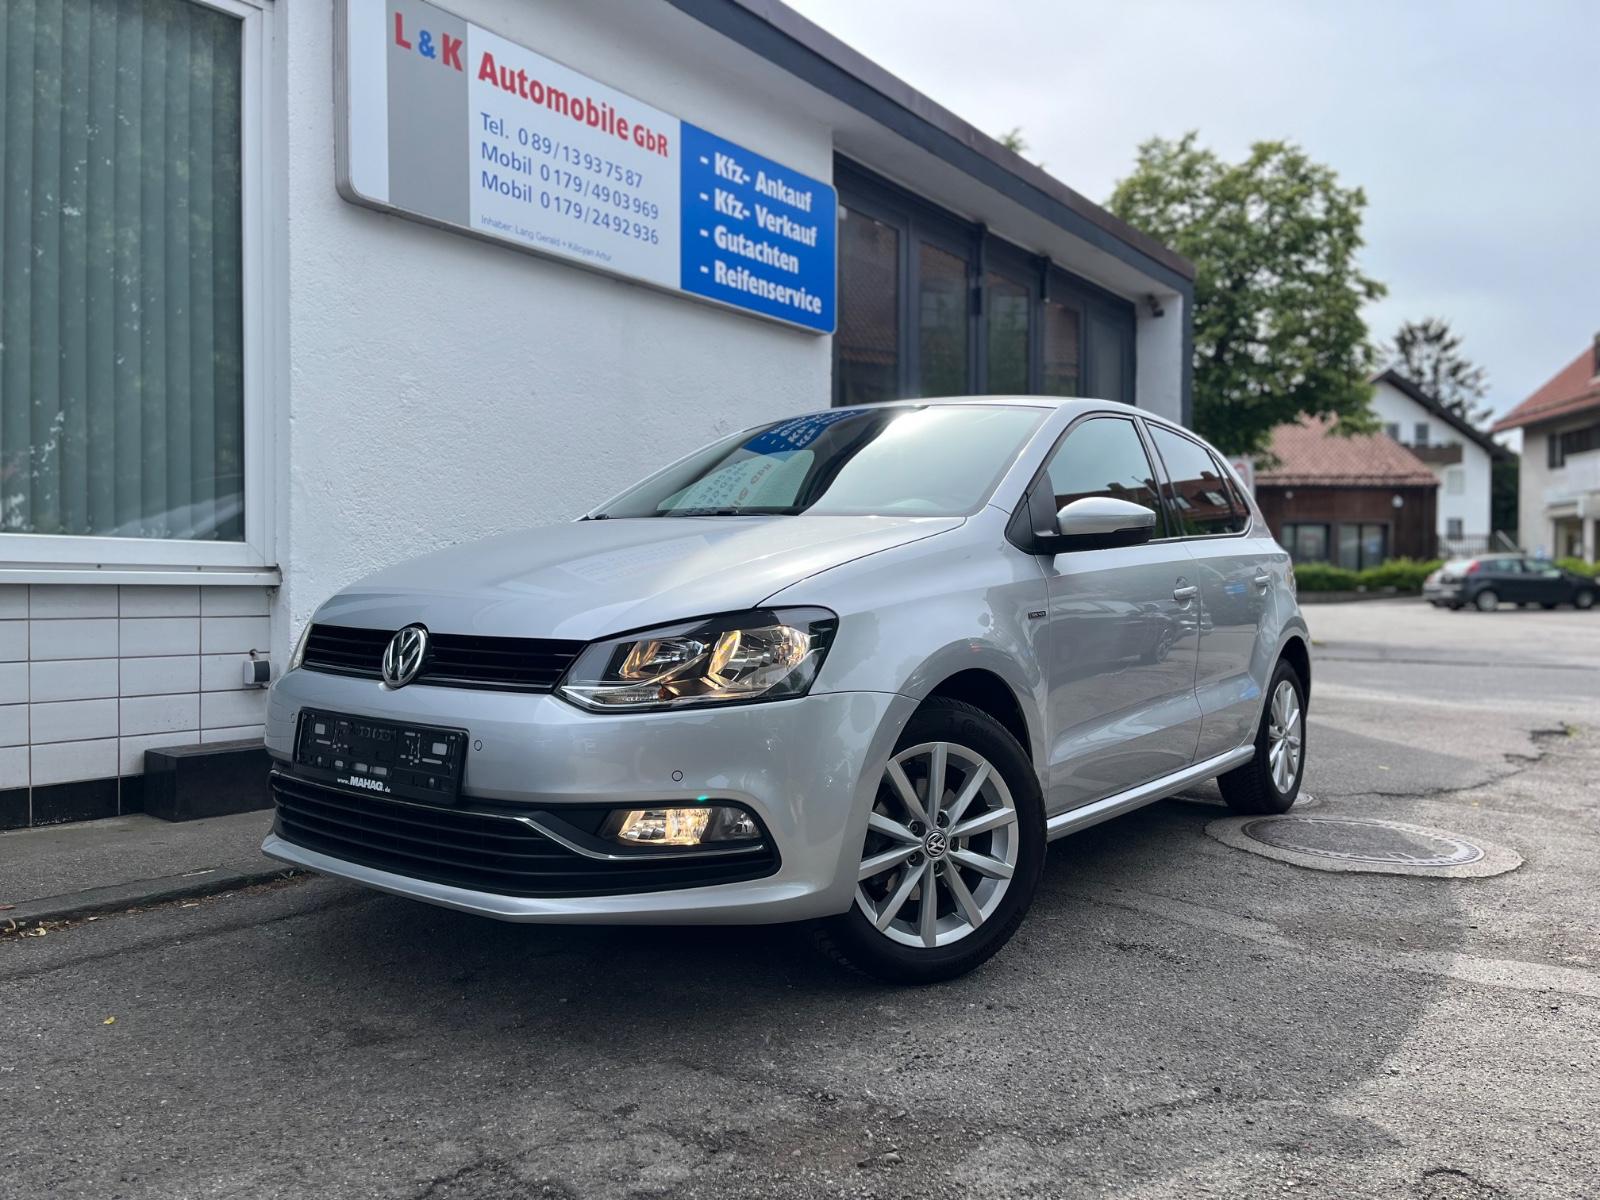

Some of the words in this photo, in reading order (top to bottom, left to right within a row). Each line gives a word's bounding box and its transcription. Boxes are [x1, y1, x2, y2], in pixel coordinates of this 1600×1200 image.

[394, 12, 412, 50] L
[417, 30, 437, 60] &
[442, 33, 463, 72] K
[478, 51, 628, 141] Automobile
[633, 124, 669, 158] GbR
[480, 111, 510, 140] Tel.
[481, 141, 532, 176] Mobil
[481, 170, 532, 204] Mobil
[754, 171, 812, 213] Ankauf
[754, 204, 817, 247] Verkauf
[714, 225, 799, 274] Gutachten
[714, 260, 822, 314] Reifenservice
